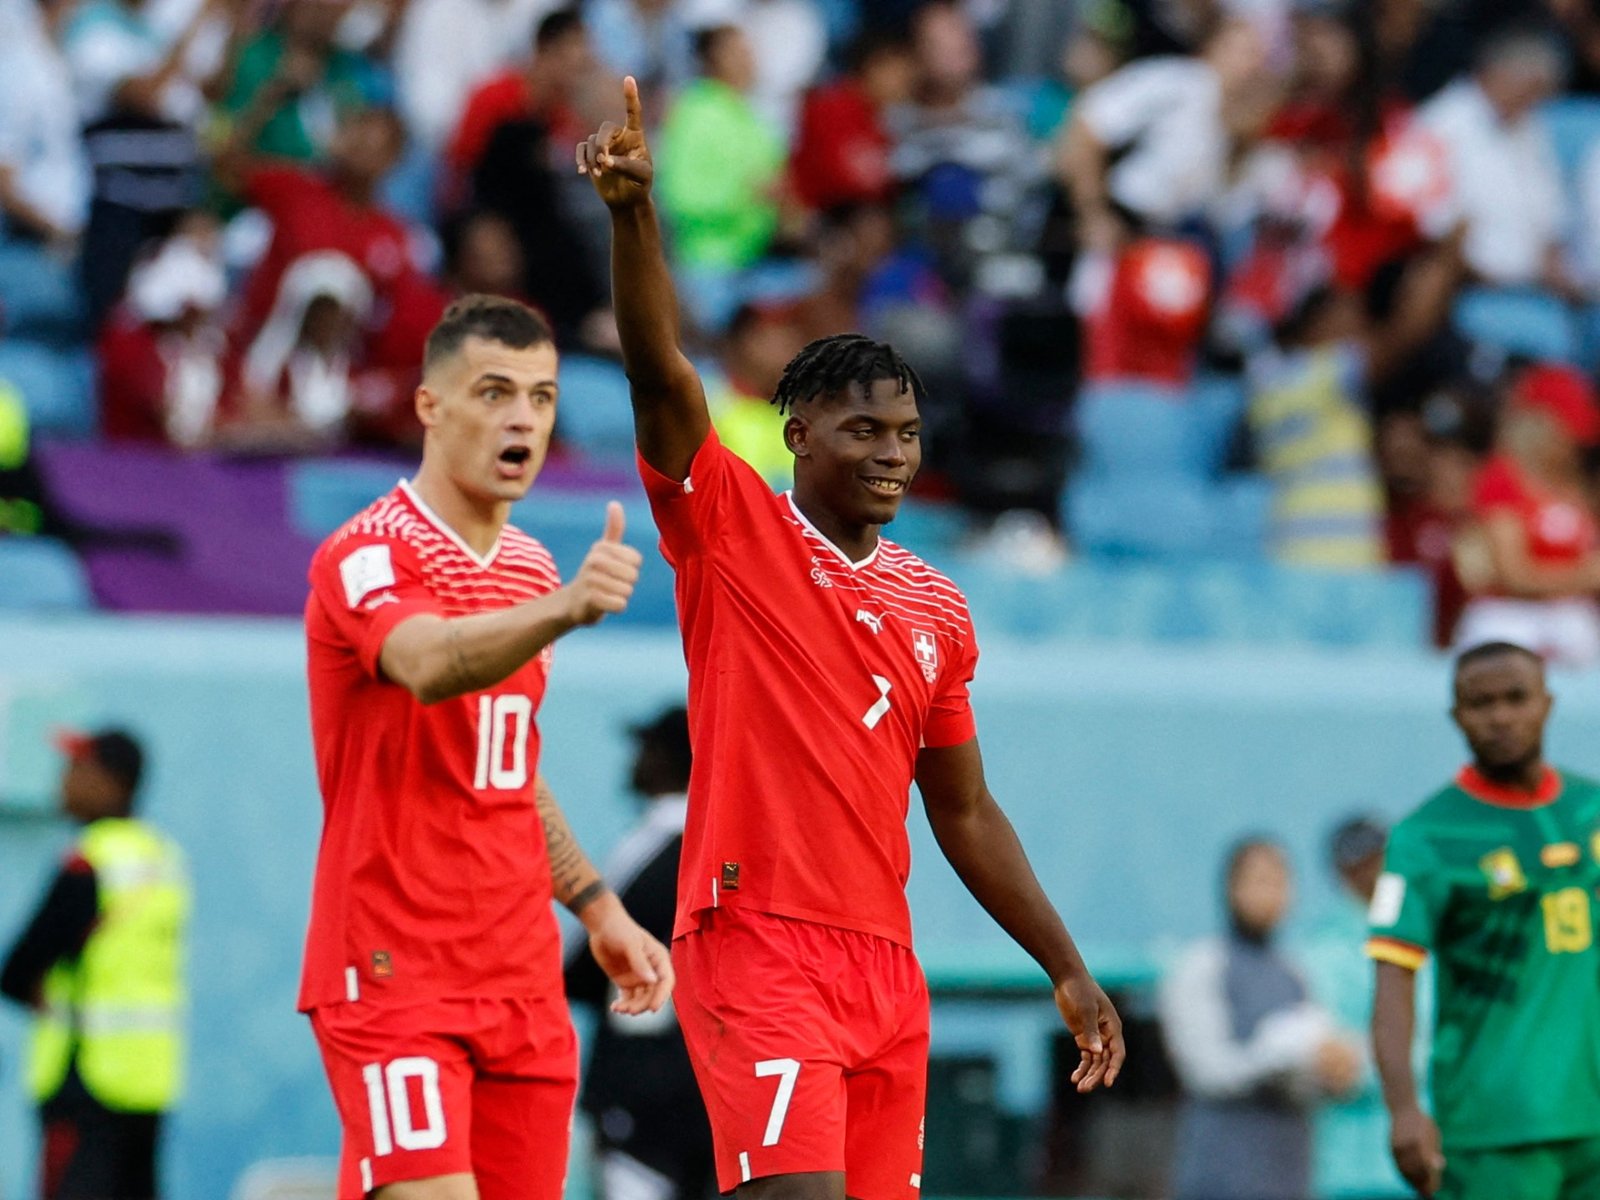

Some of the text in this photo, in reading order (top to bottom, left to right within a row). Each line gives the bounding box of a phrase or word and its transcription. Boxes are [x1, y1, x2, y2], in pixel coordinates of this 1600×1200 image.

[473, 694, 532, 790] 10
[1541, 887, 1592, 953] 19
[362, 1056, 448, 1156] 10
[755, 1058, 800, 1147] 7
